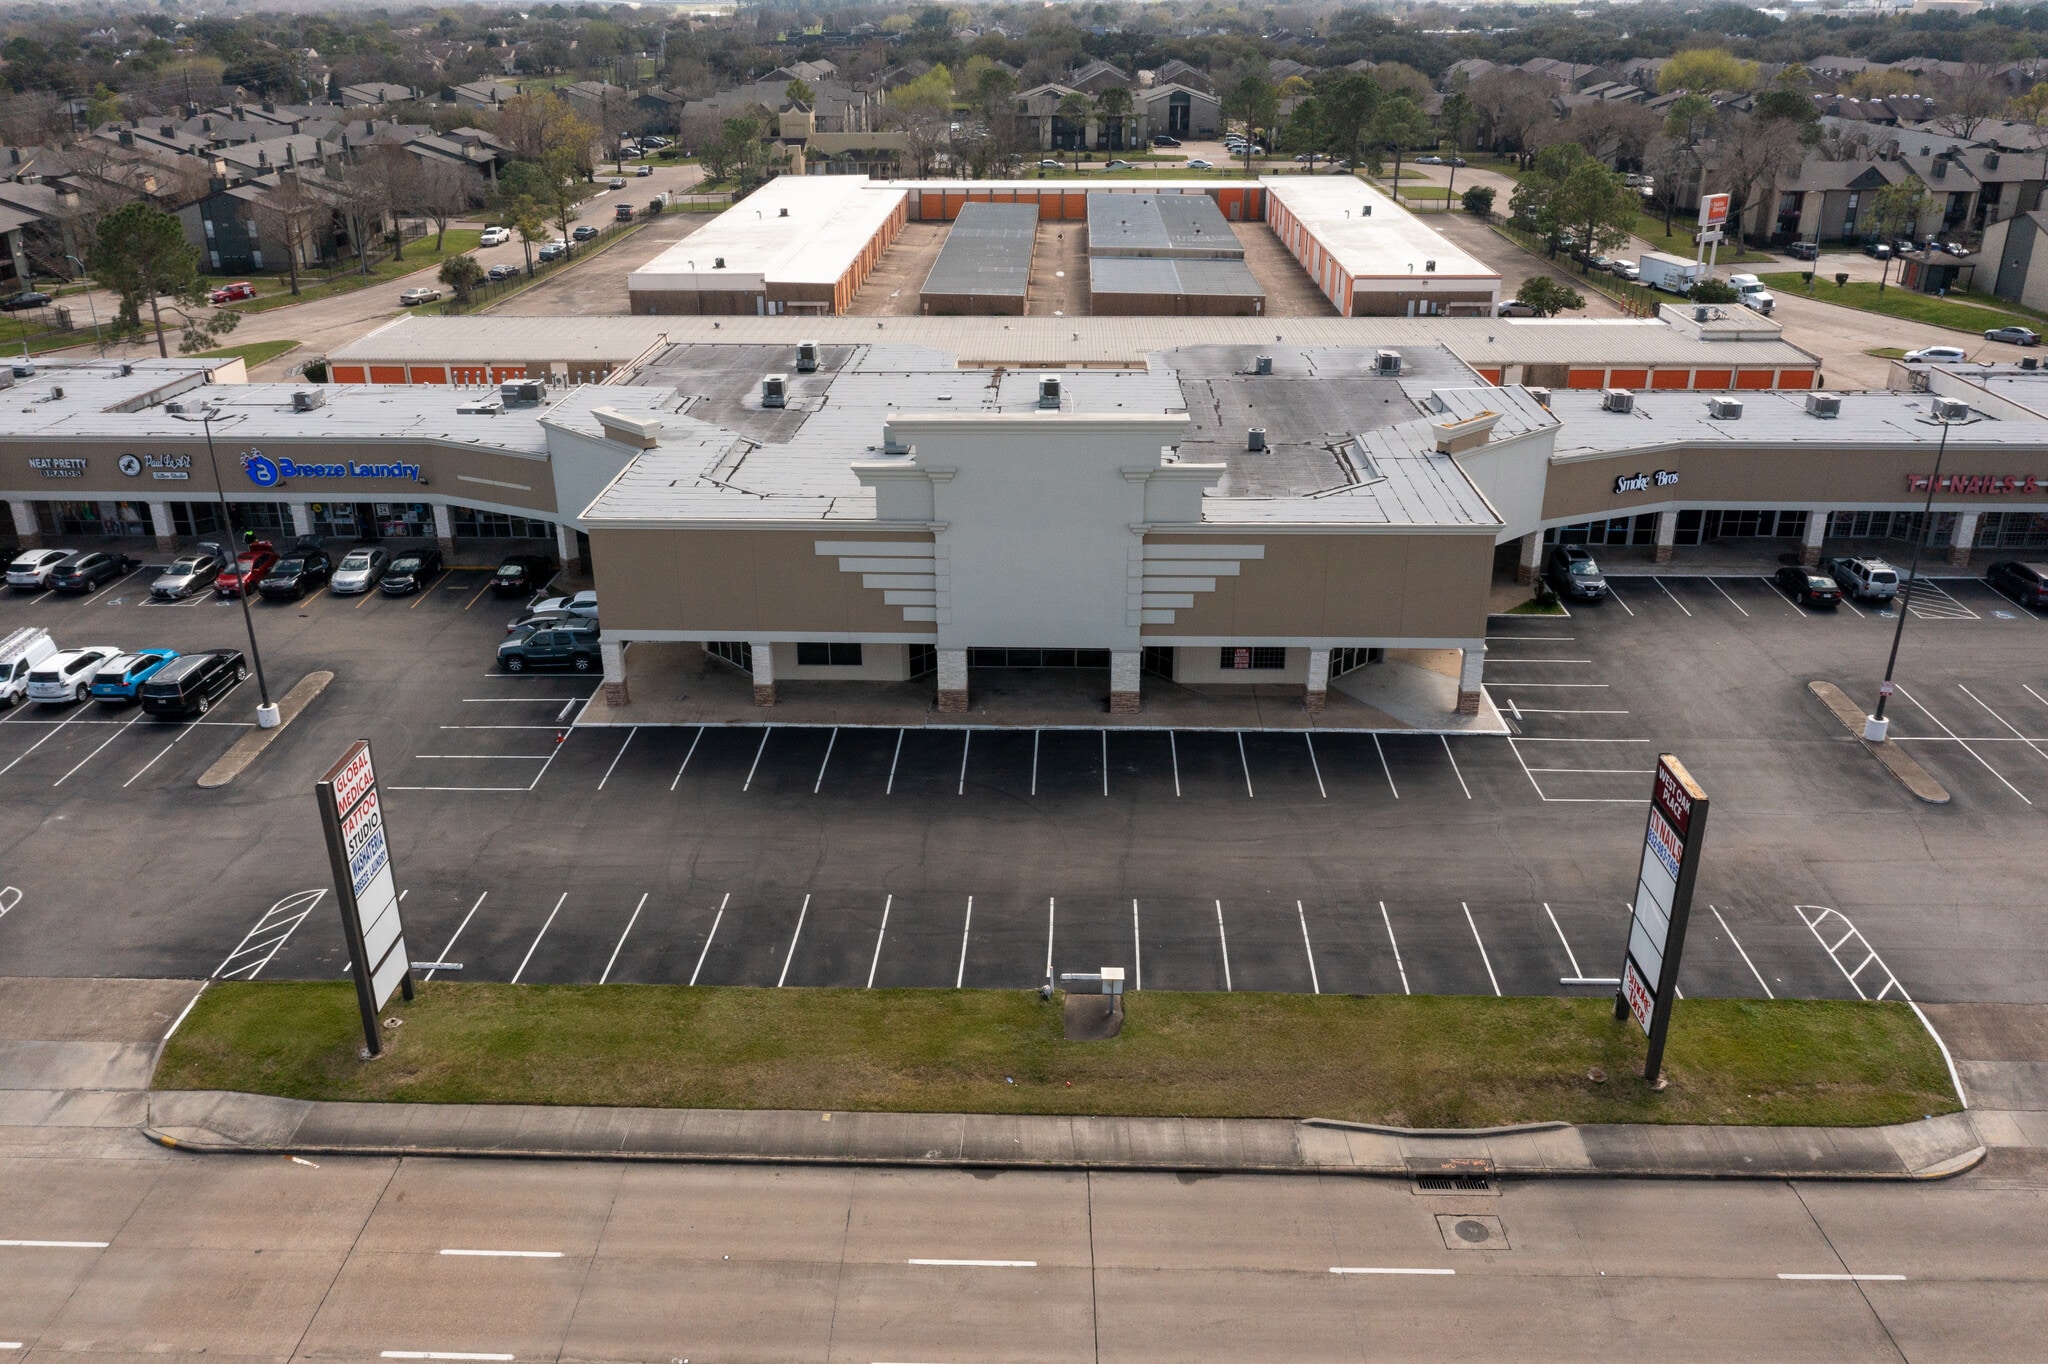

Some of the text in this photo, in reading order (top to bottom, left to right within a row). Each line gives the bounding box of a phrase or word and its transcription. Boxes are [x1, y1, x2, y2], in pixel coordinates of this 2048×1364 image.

[28, 458, 87, 469] NEAT PRETTY
[41, 469, 82, 477] BRAIDS
[144, 454, 163, 468] Paul
[279, 456, 420, 482] Breeze Laundry
[1615, 470, 1679, 494] Smoke Bros
[1949, 474, 2016, 494] NAILS
[2022, 474, 2039, 494] &
[336, 751, 368, 793] GLOBAL
[1659, 765, 1691, 815] WEST OAK
[338, 768, 374, 817] MEDICAL
[1662, 788, 1683, 820] PLACE
[342, 792, 377, 838] TATTOO
[348, 812, 379, 855] STUDIO
[351, 829, 384, 880] WASHATERIA
[1659, 825, 1683, 865] NAILS
[354, 850, 387, 897] BREEZE LAUNDRY
[1626, 965, 1651, 1015] Smoke
[1628, 985, 1645, 1025] Bros
